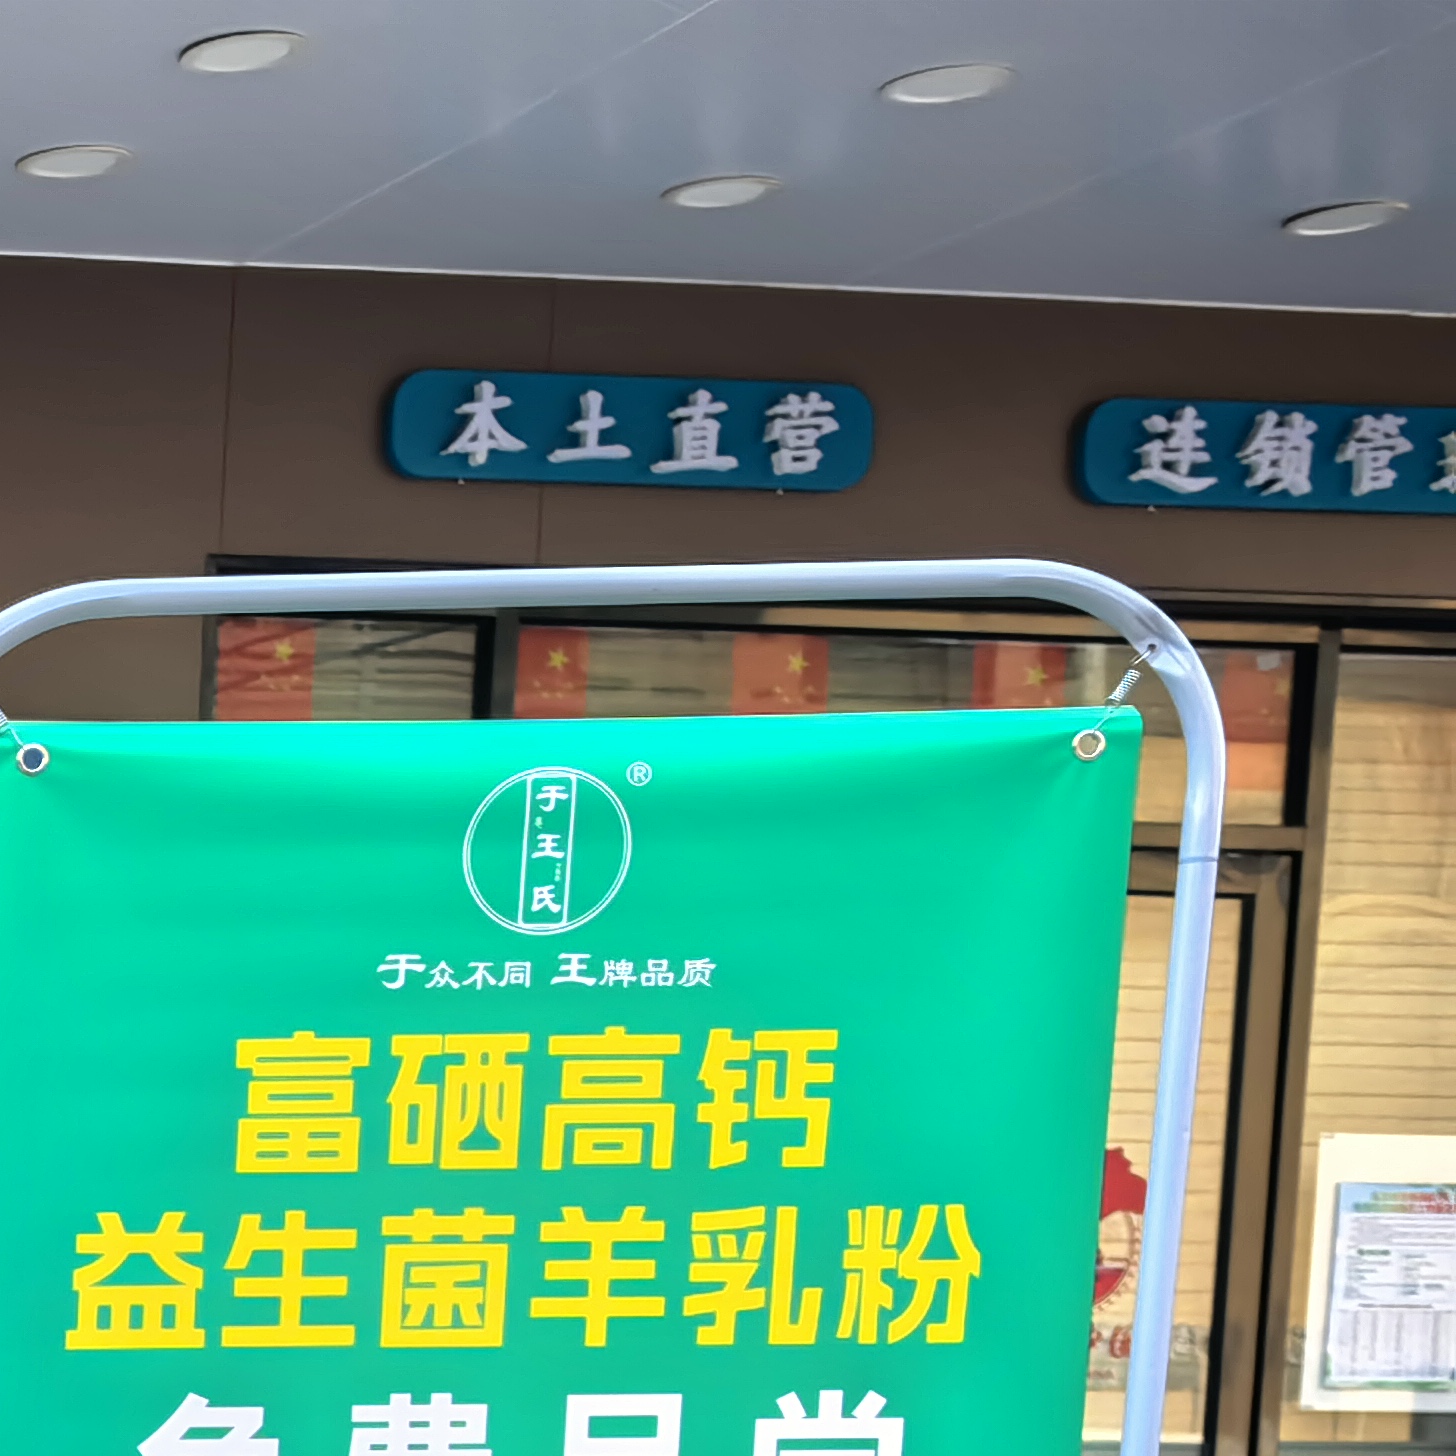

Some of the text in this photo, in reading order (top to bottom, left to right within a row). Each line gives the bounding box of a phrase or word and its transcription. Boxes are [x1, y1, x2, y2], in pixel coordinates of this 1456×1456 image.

[440, 381, 840, 478] 本土直营
[531, 785, 569, 913] 于王氏
[377, 951, 716, 991] 于众不同 王牌品质
[234, 1026, 839, 1174] 富硒高钙
[64, 1203, 982, 1350] 益生菌羊乳粉
